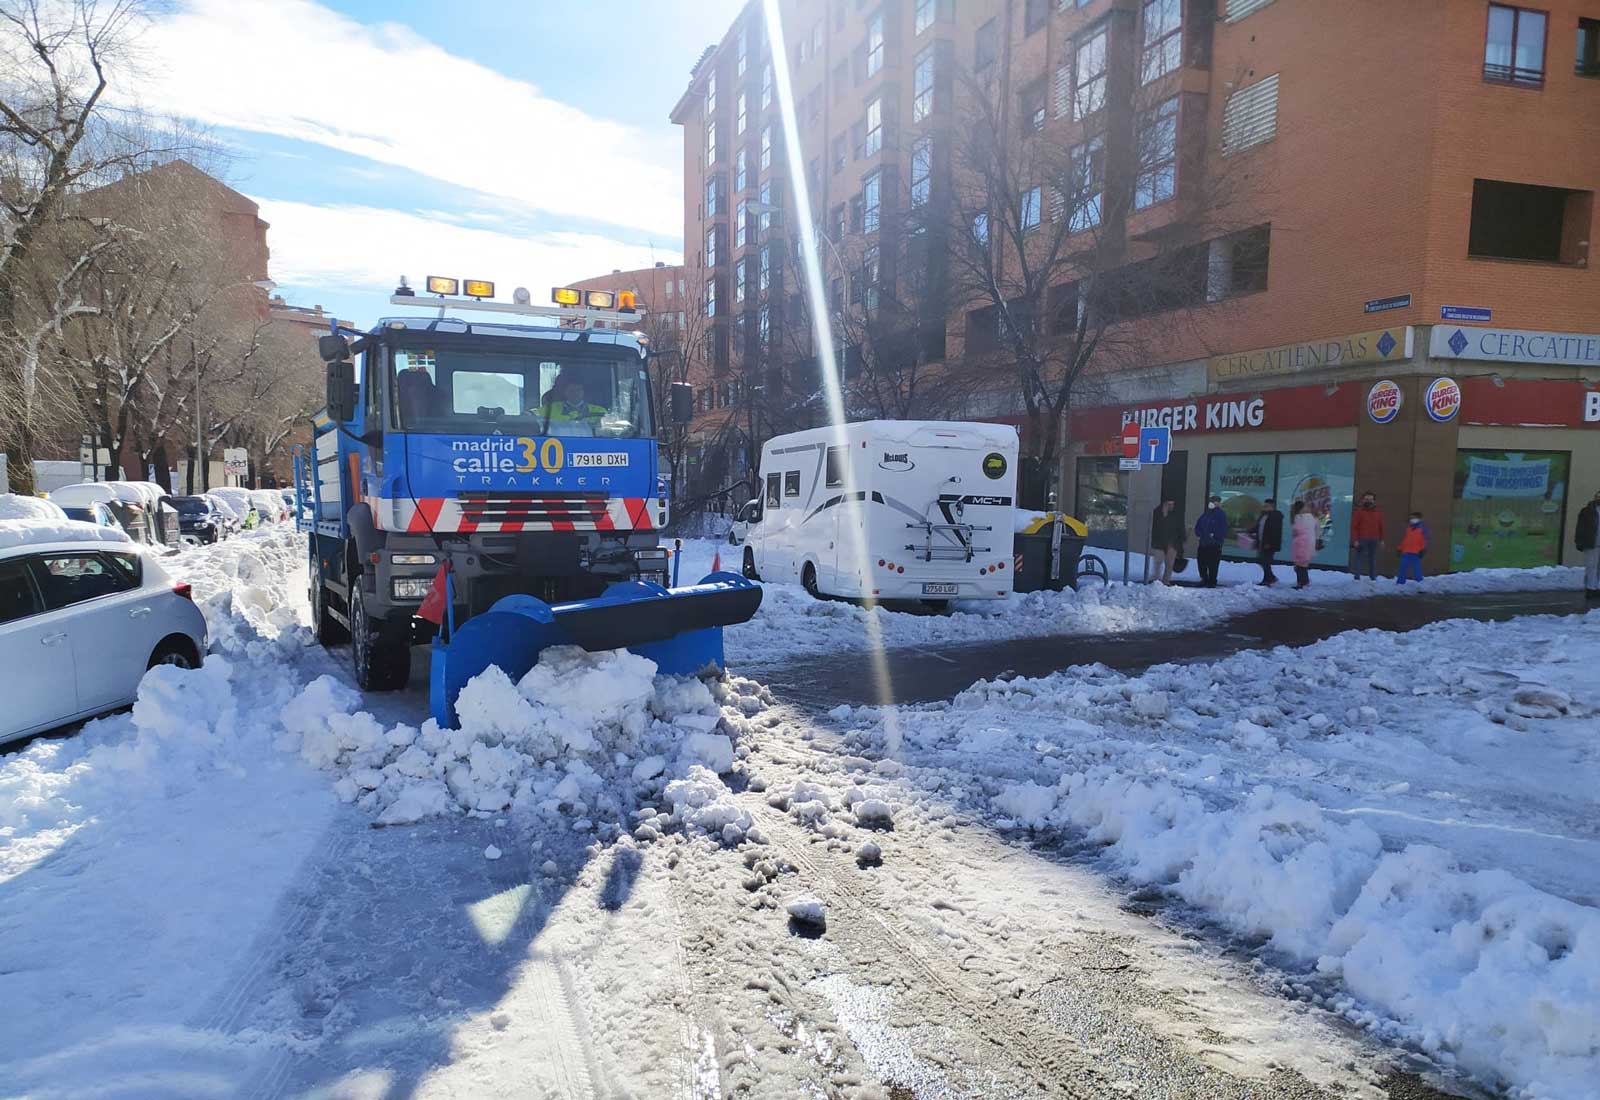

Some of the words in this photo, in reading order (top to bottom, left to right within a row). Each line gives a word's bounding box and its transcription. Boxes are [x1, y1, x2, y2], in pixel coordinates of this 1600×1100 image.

[1480, 333, 1600, 361] CERCATIE
[1215, 336, 1368, 377] CERCATIENDAS
[1371, 388, 1398, 400] BURGER
[1431, 385, 1458, 400] BURGER
[1370, 396, 1398, 411] KING
[1432, 393, 1460, 411] KING
[1205, 398, 1265, 429] KING
[452, 438, 514, 452] madrid
[453, 452, 515, 473] calle
[515, 436, 564, 474] 30
[576, 454, 603, 466] 7918
[607, 454, 628, 466] DXH
[456, 475, 611, 486] TRAKKER
[1219, 474, 1266, 487] WHOPPER
[972, 496, 1003, 505] MC4
